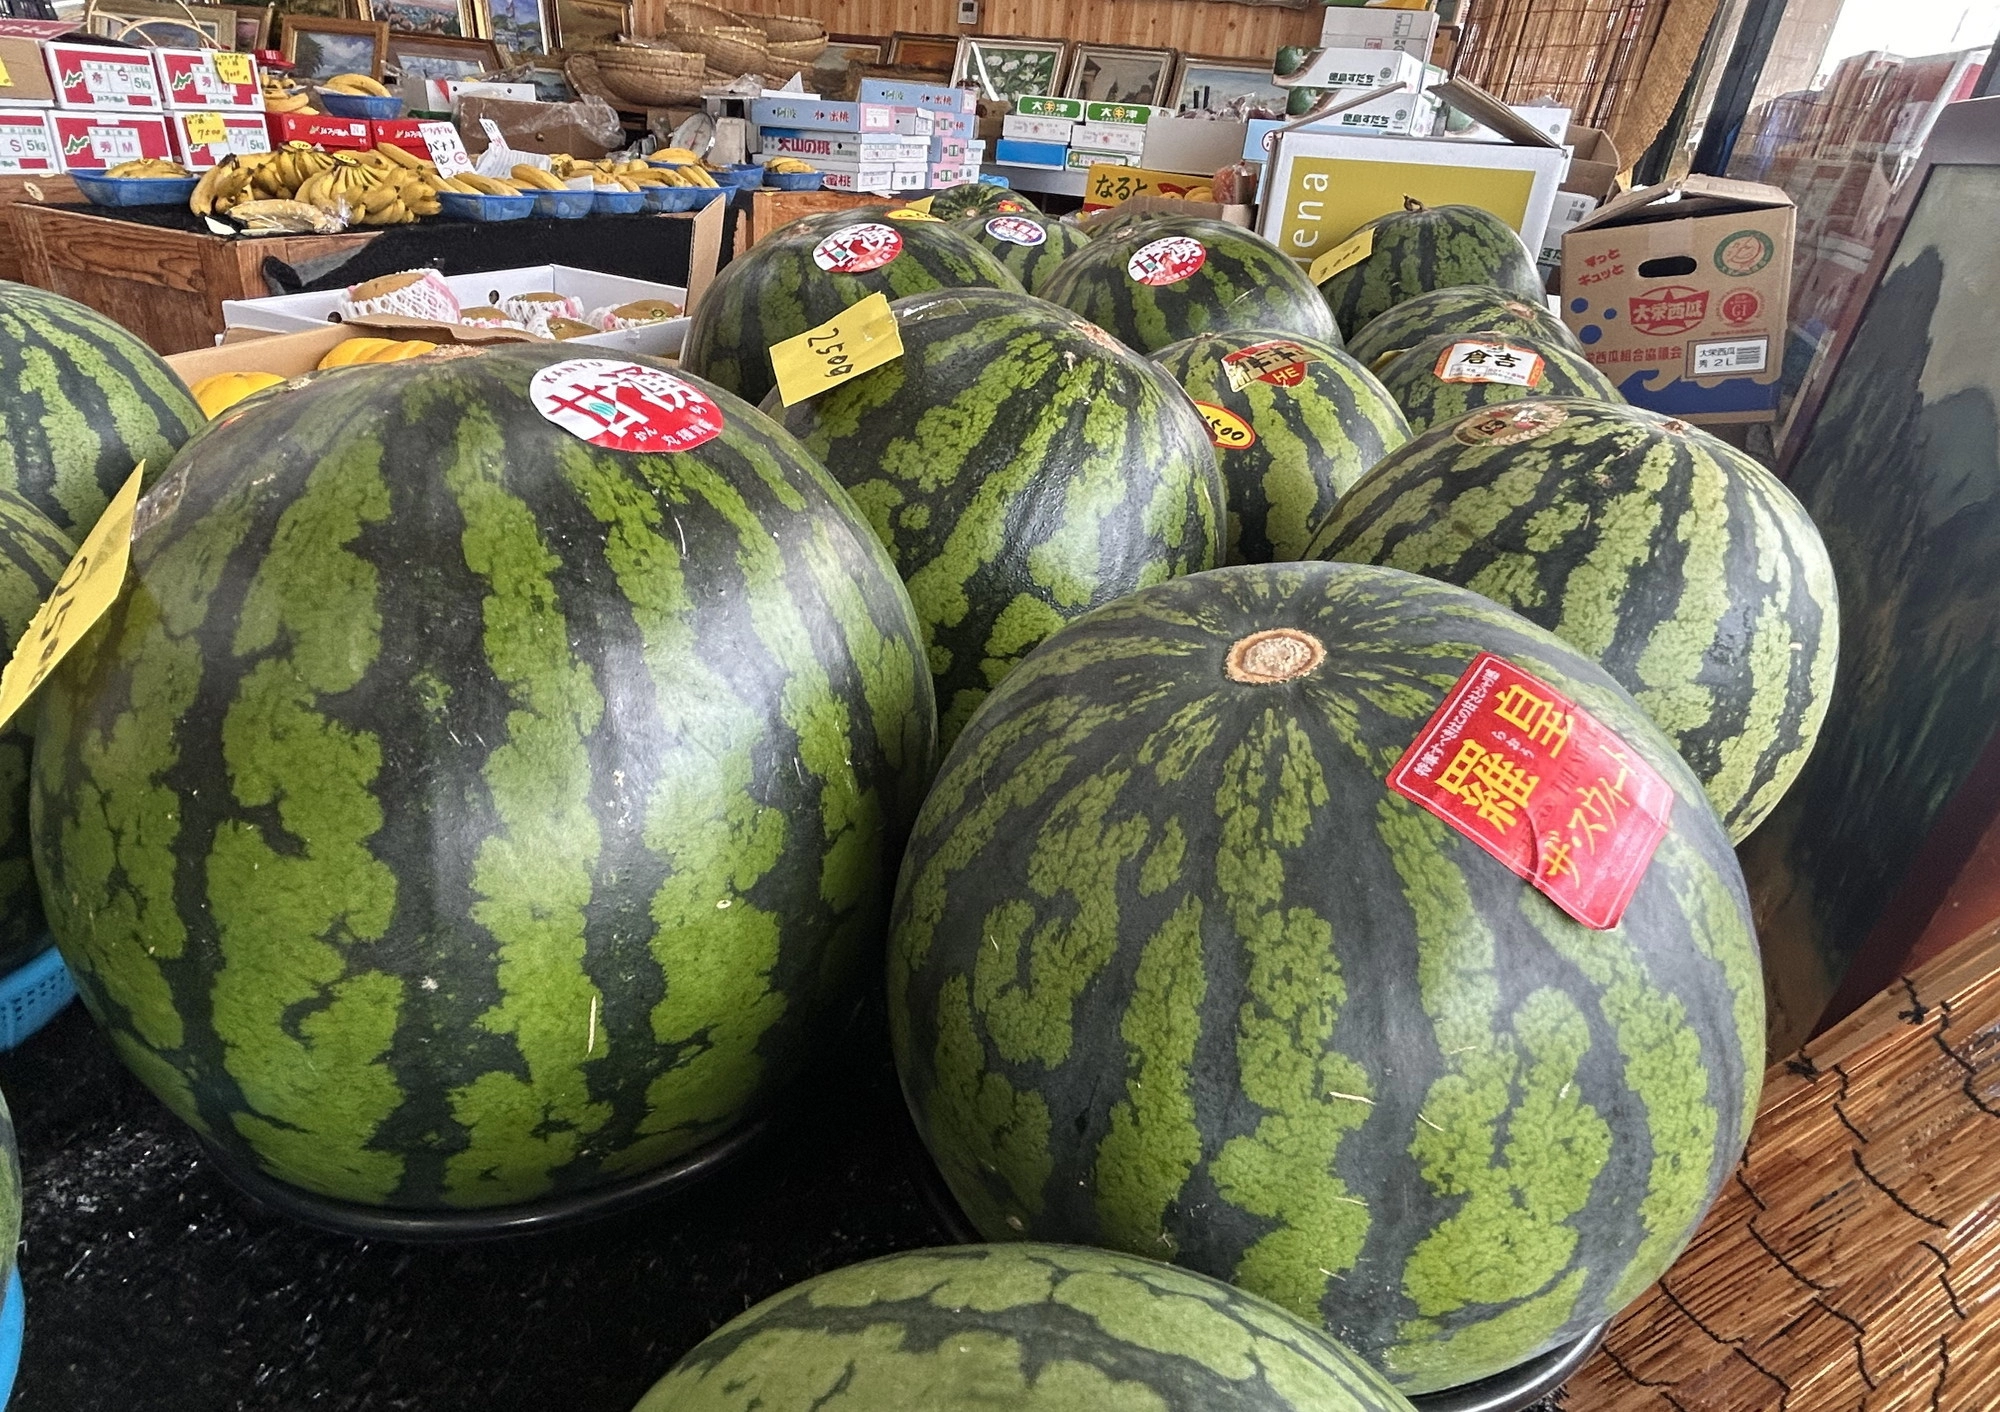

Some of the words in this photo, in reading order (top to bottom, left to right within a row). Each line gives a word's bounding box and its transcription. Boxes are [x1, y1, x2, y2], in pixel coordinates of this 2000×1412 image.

[117, 69, 129, 82] S
[134, 77, 151, 90] 5kg
[10, 140, 22, 152] S
[26, 140, 47, 152] 5kg
[122, 142, 133, 152] M
[1095, 174, 1148, 200] なると
[1633, 300, 1703, 322] 大栄西瓜
[807, 327, 854, 378] 2500
[1460, 349, 1522, 368] 倉吉
[540, 361, 604, 384] KANYU
[1542, 744, 1641, 888] ザ・スウィート
